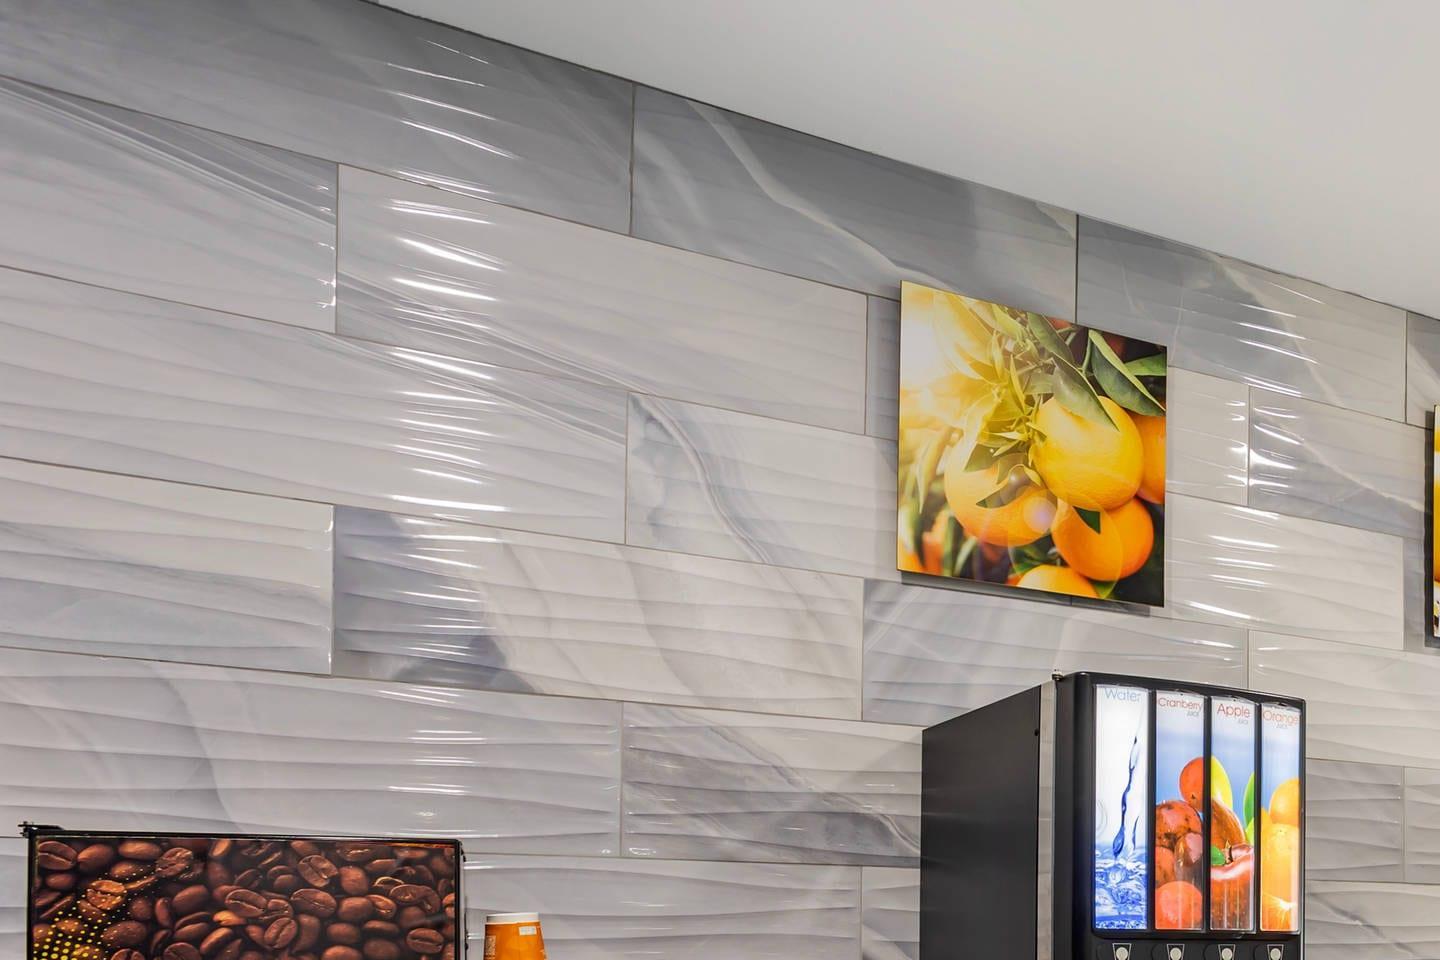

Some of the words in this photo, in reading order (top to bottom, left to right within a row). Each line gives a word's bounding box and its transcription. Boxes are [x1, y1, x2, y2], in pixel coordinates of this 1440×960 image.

[1104, 687, 1140, 702] Water
[1158, 697, 1202, 711] Cranberry
[1217, 703, 1250, 718] Apple
[1262, 710, 1299, 726] Orange
